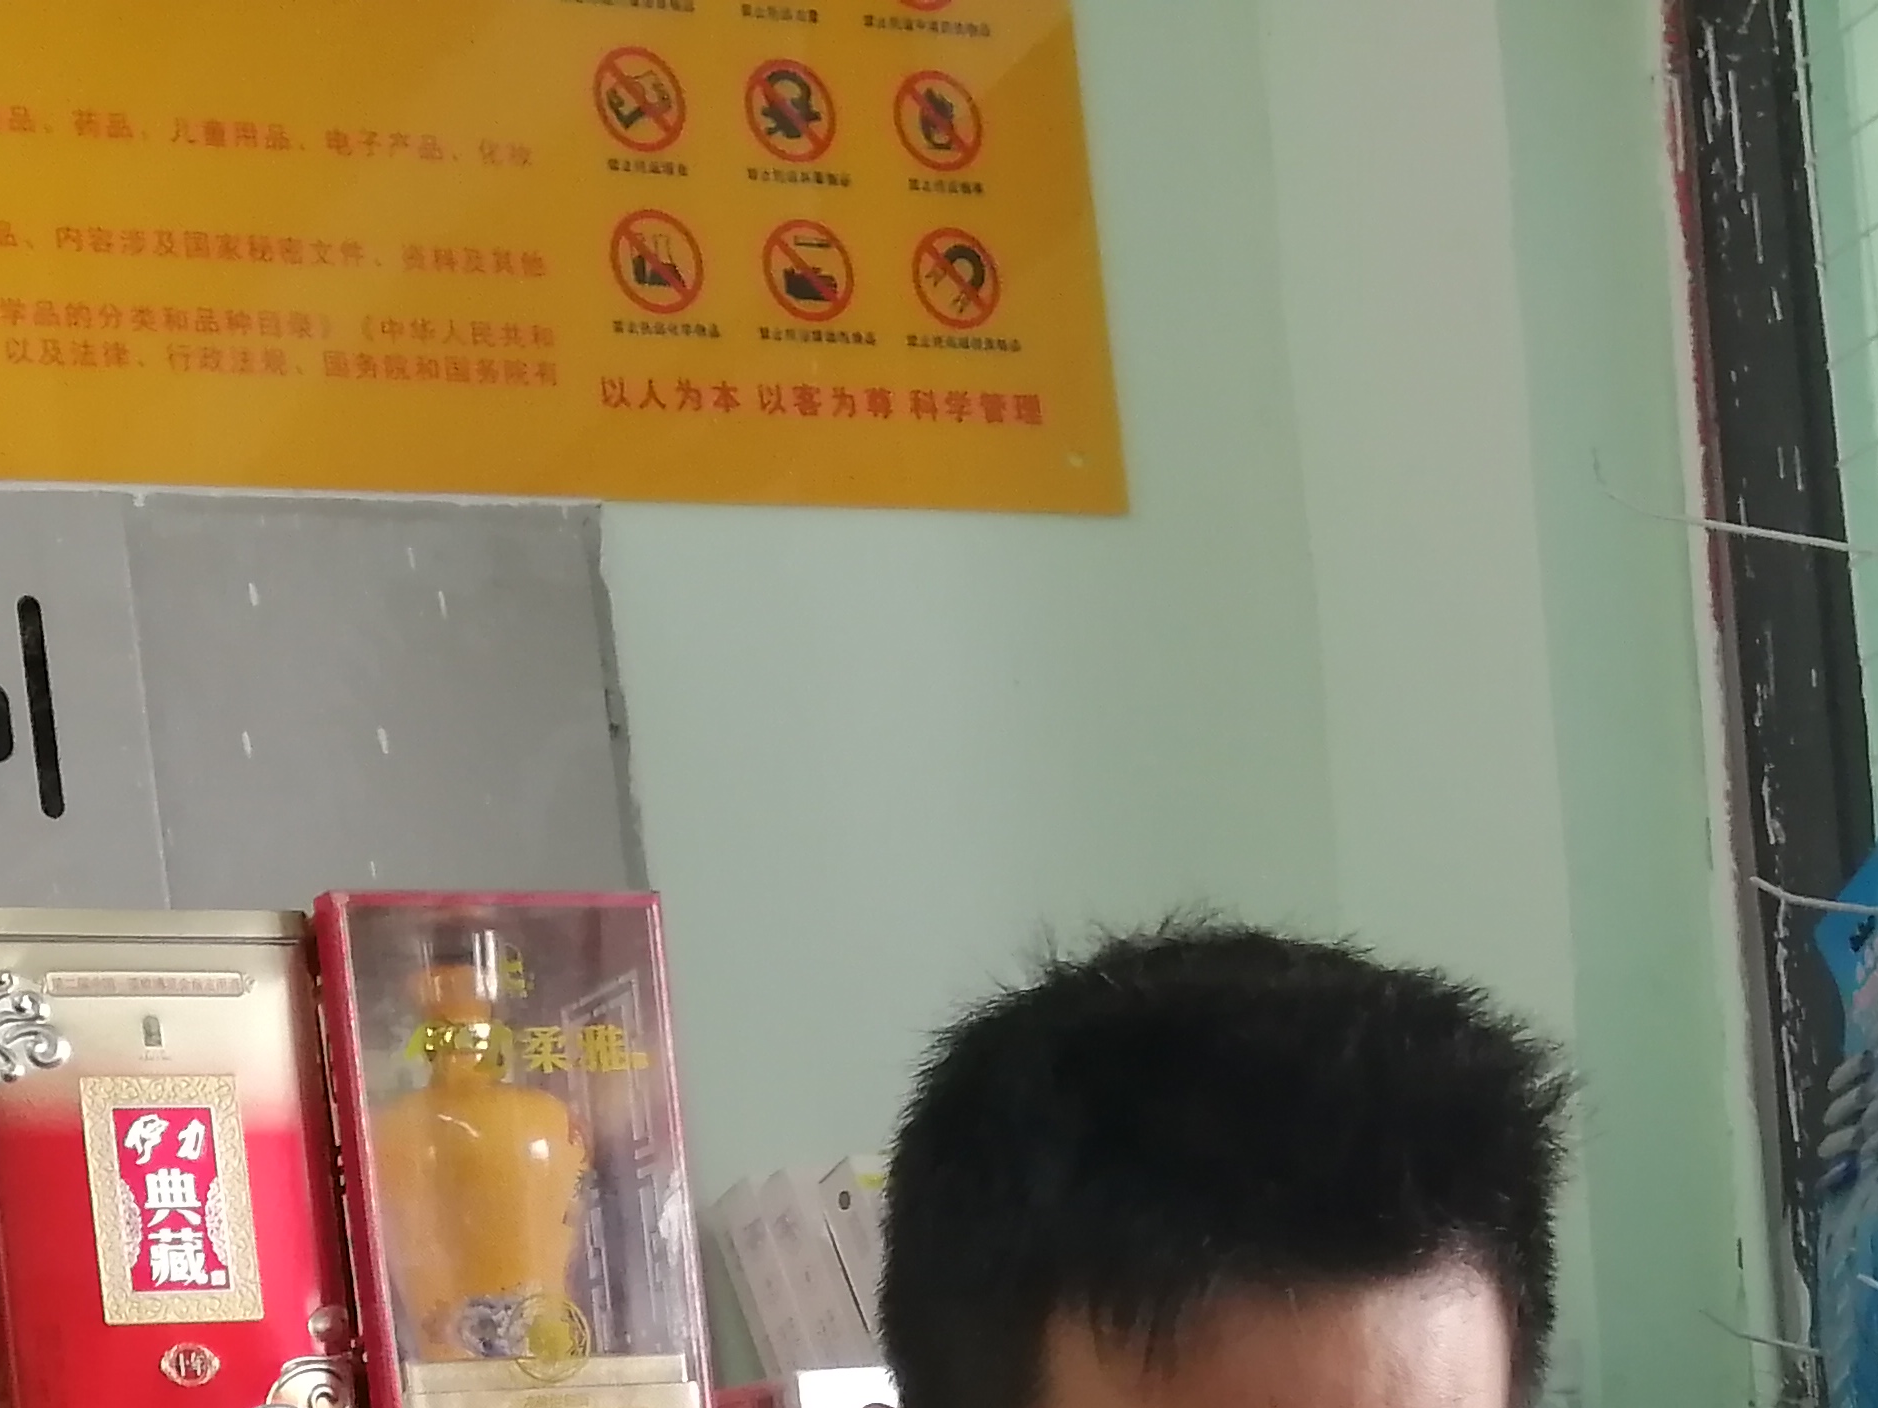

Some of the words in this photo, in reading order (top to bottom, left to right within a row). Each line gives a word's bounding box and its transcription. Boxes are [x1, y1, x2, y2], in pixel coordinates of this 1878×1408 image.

[600, 374, 741, 413] 以人为本
[757, 383, 895, 420] 以客为尊
[909, 388, 1045, 427] 科学管理
[143, 1167, 209, 1289] 典藏
